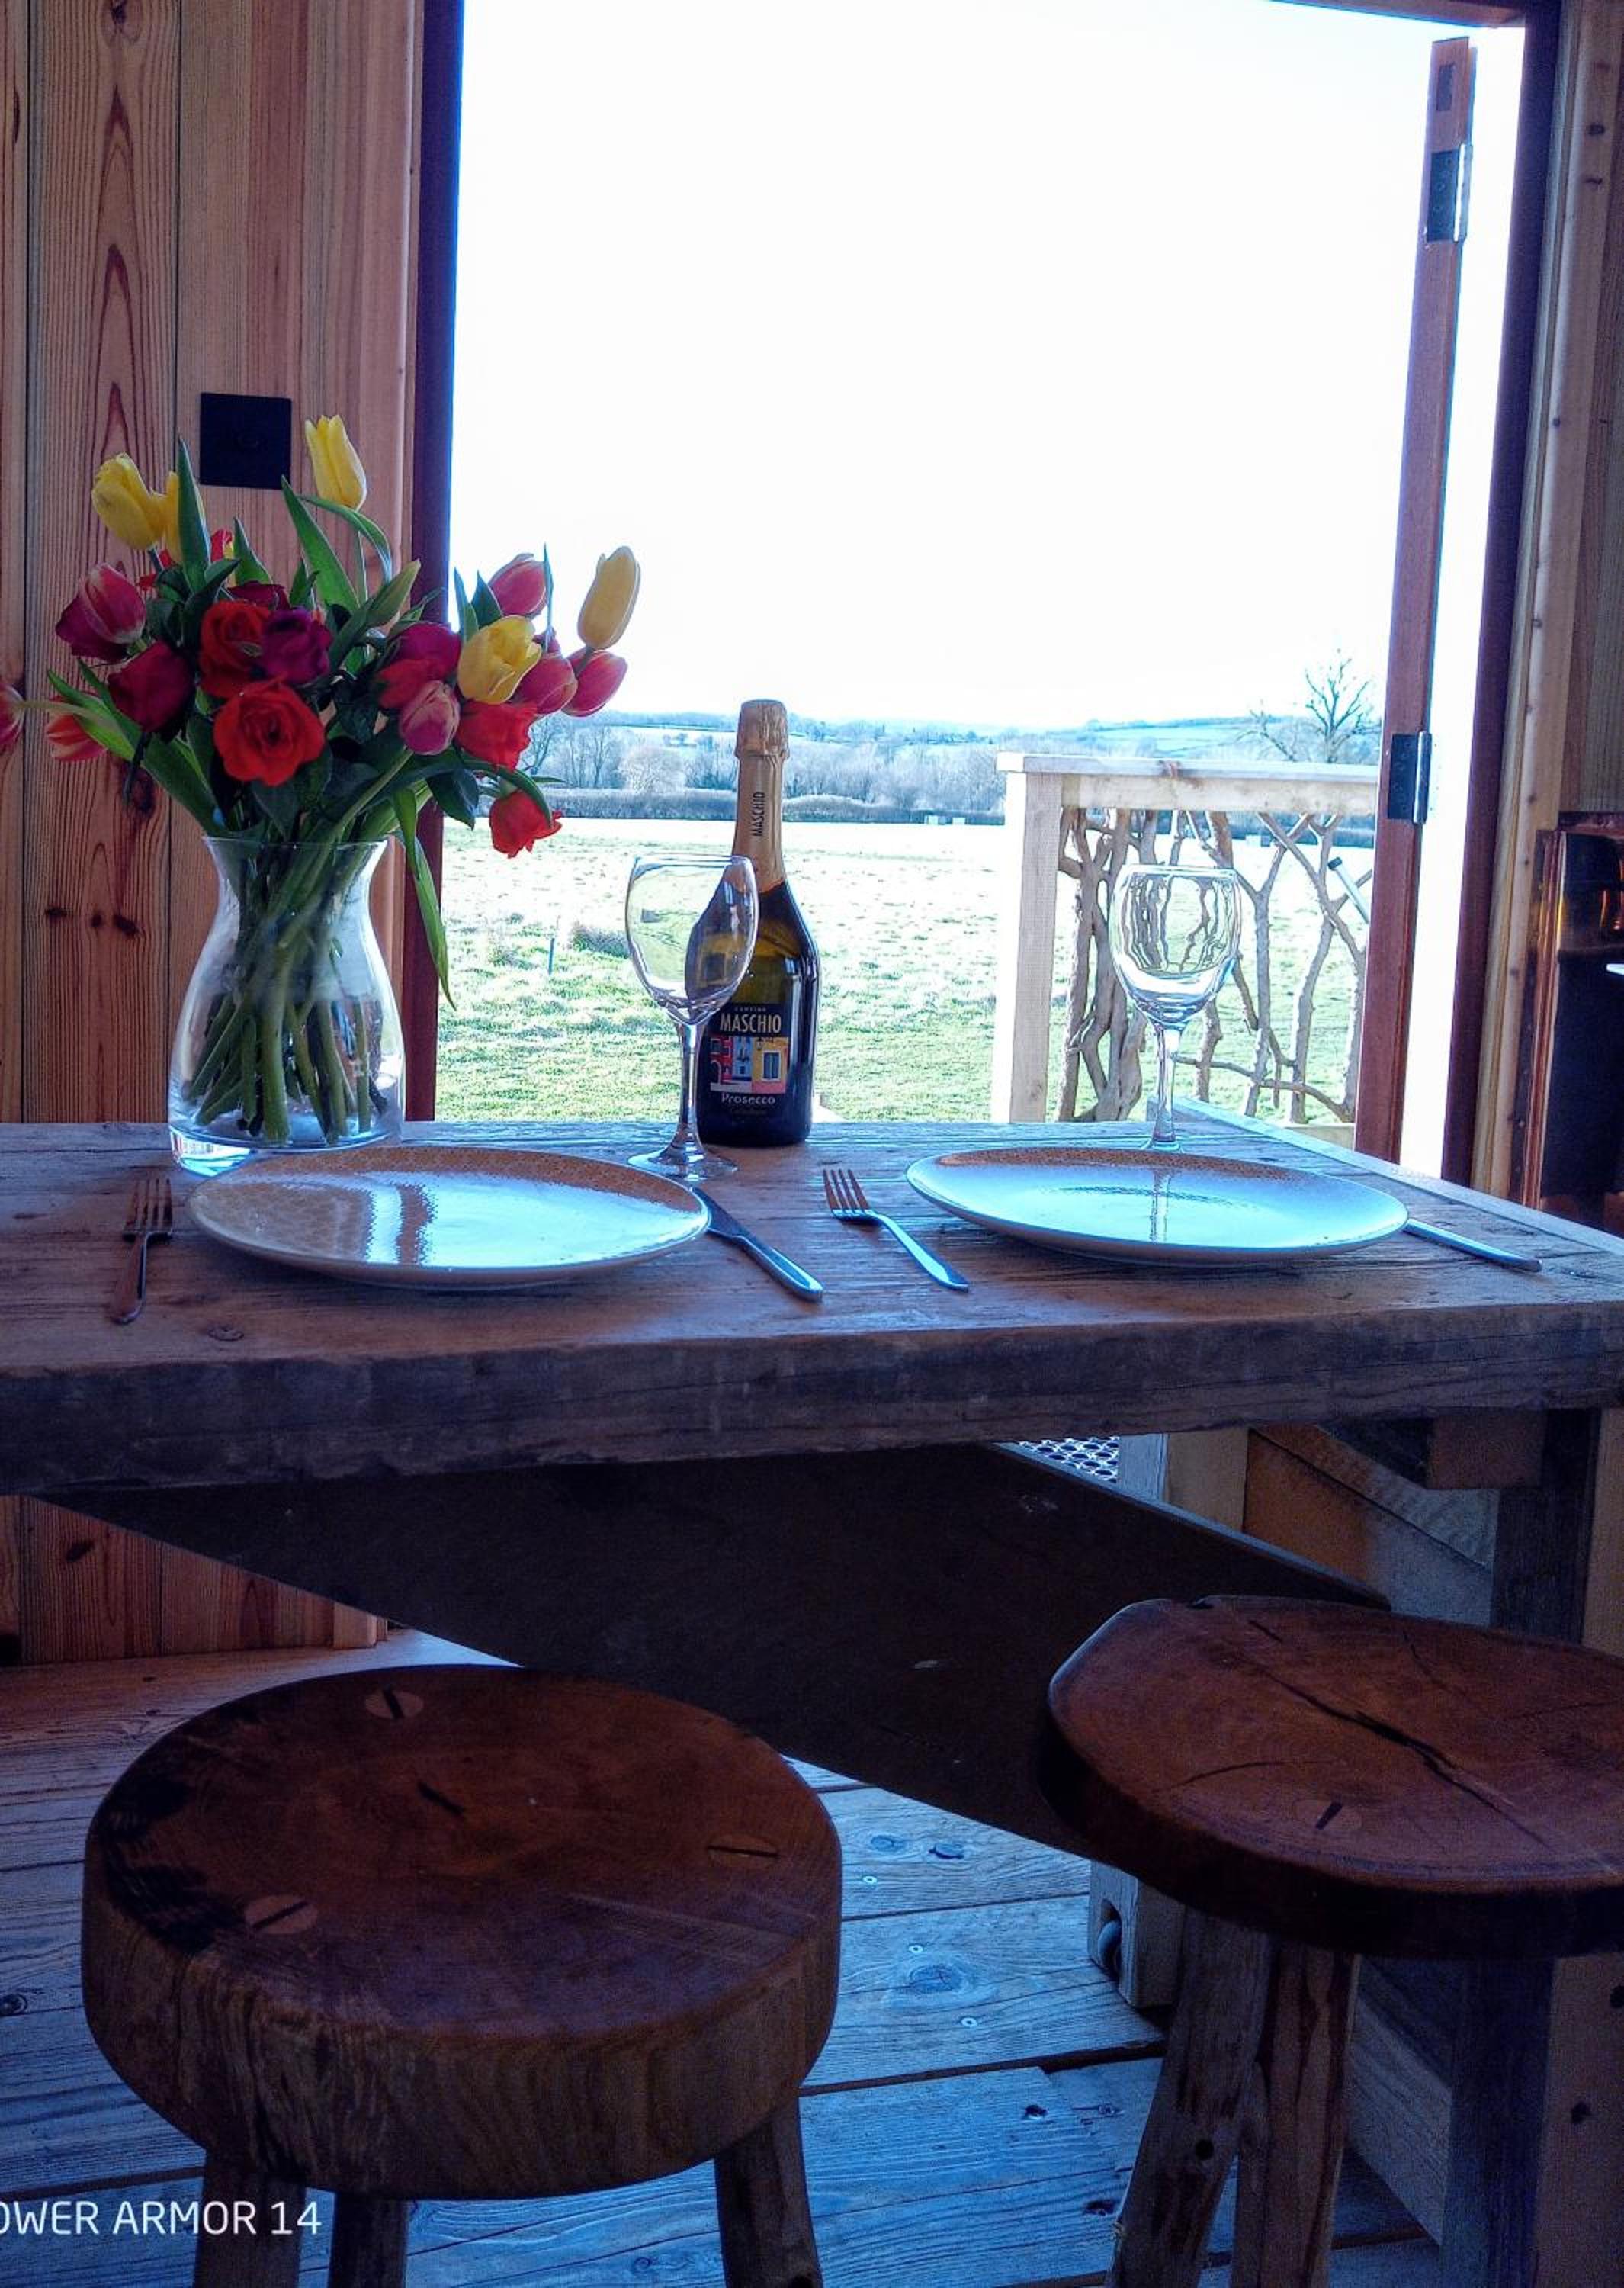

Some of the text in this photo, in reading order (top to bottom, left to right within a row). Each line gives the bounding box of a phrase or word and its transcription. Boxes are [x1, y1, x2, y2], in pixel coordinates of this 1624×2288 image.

[751, 792, 765, 837] MASCHIO
[720, 1013, 782, 1033] MASCHIO
[721, 1093, 775, 1104] Prosecco
